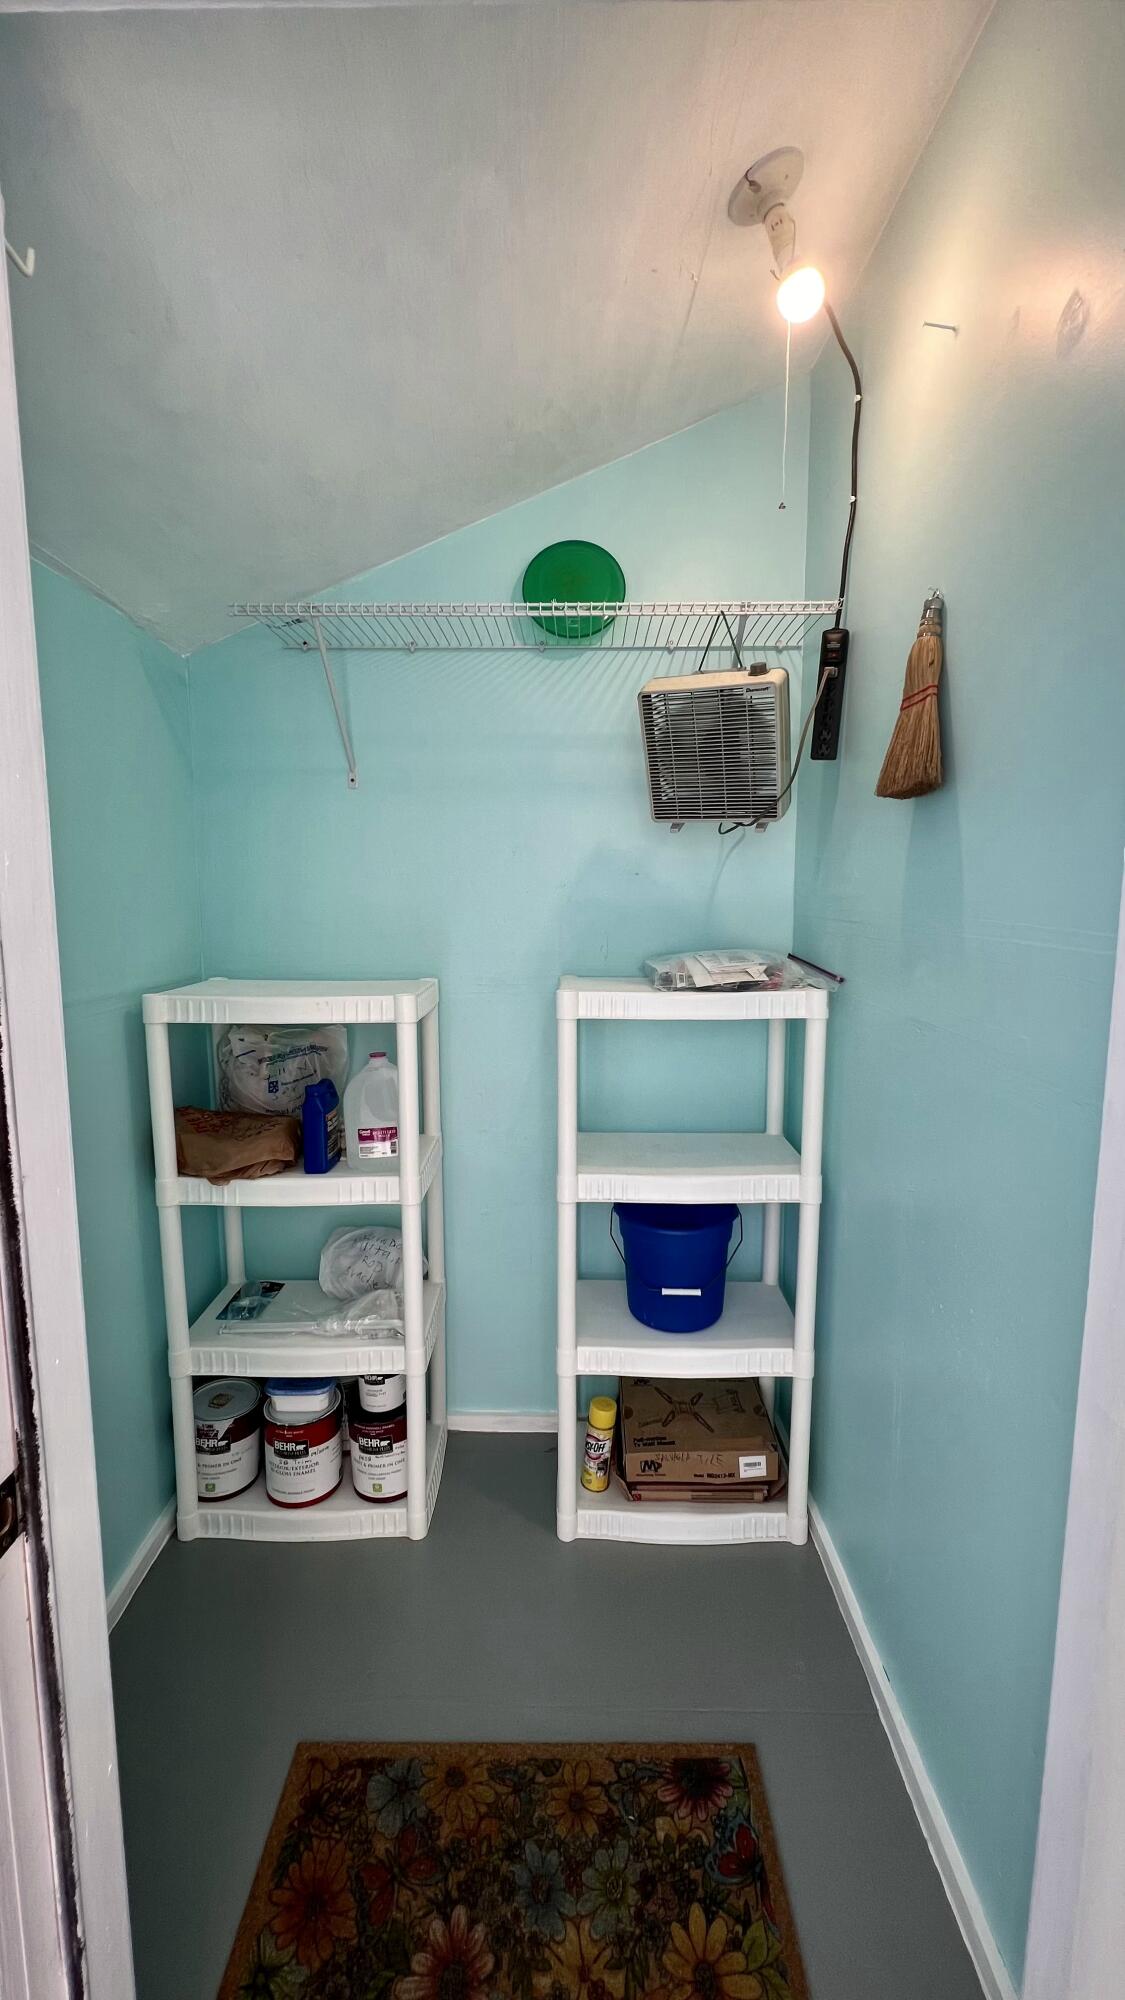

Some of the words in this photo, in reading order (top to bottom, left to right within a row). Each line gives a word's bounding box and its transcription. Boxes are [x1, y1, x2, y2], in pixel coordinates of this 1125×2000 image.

[195, 1438, 218, 1448] BEHR
[274, 1440, 297, 1452] BEHR
[359, 1437, 380, 1447] BEHR
[585, 1440, 607, 1453] ASY-OFF
